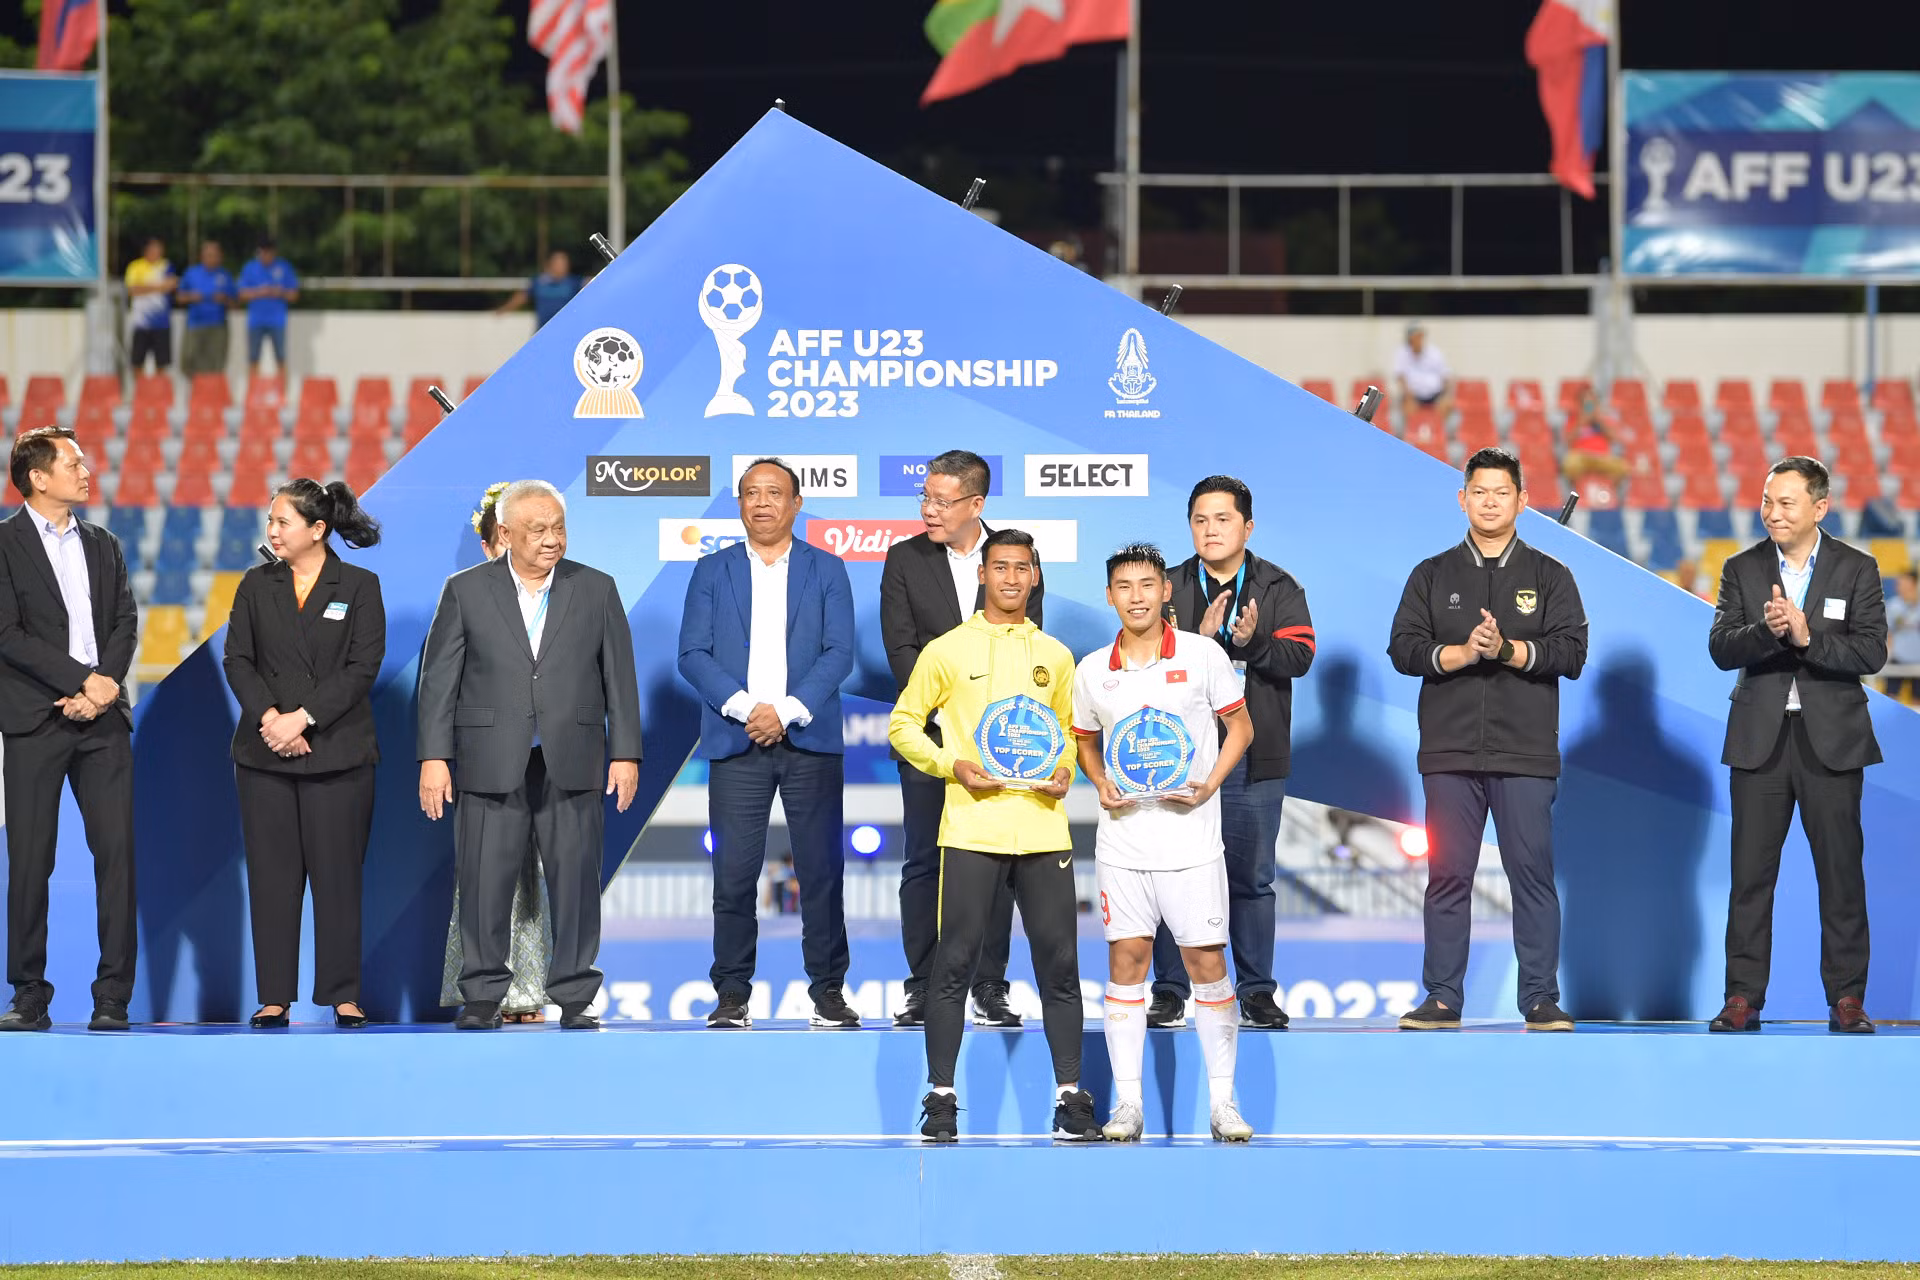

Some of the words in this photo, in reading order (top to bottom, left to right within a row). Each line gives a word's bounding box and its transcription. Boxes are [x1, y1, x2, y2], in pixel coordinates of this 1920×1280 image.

[1682, 151, 1811, 202] AFF
[1823, 151, 1920, 202] U2
[767, 329, 843, 356] AFF
[854, 329, 924, 357] U23
[767, 359, 1059, 388] CHAMPIONSHIP
[767, 390, 859, 418] 2023
[1104, 410, 1115, 418] FA
[1117, 410, 1161, 418] THAILAND
[801, 468, 847, 487] IMS
[1040, 464, 1133, 487] SELECT
[825, 520, 913, 556] Vidi
[994, 746, 1010, 754] TOP
[1012, 748, 1044, 758] SCORER
[1126, 763, 1141, 771] TOP
[1143, 760, 1175, 769] SCORER
